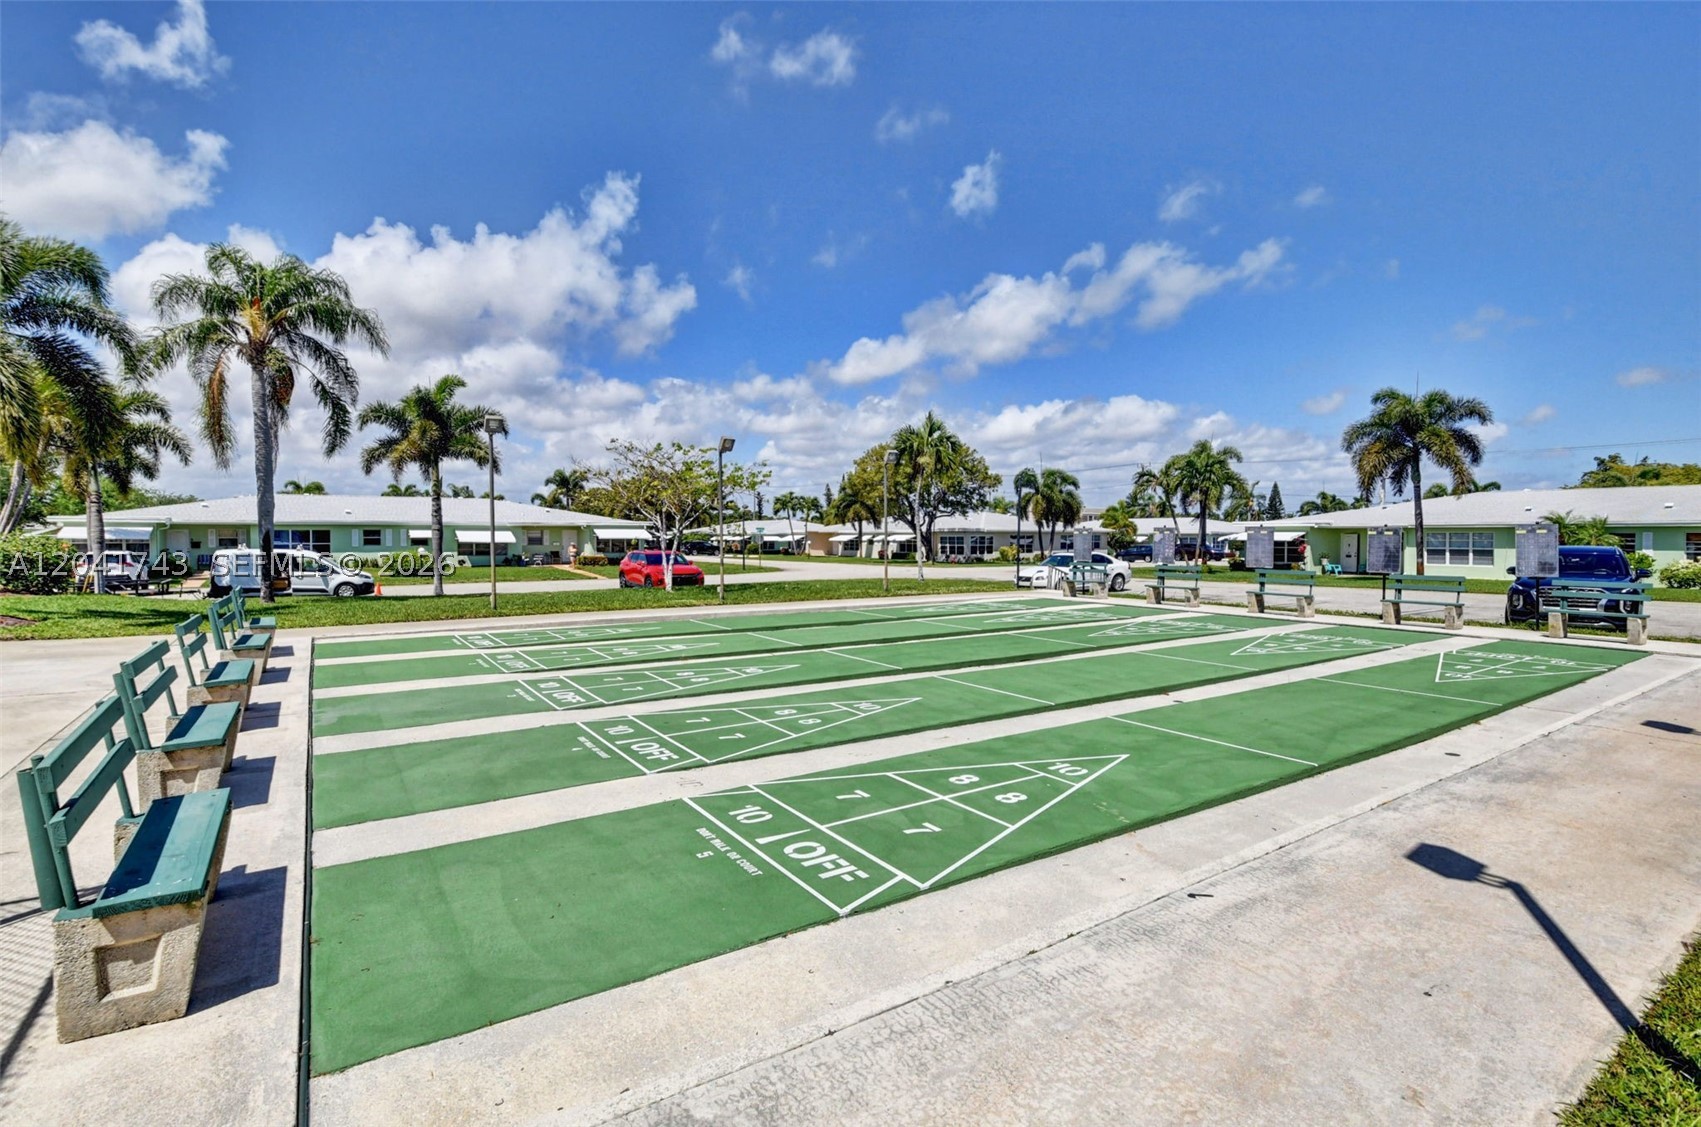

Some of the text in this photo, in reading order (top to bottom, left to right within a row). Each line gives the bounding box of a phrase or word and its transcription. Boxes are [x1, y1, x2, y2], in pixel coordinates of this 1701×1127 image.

[604, 725, 679, 760] 10 OFF
[1048, 762, 1088, 776] 10
[948, 774, 980, 785] 8
[836, 789, 871, 800] 7
[994, 792, 1028, 804] 8
[903, 822, 942, 834] 7
[727, 805, 870, 882] 10 OFF
